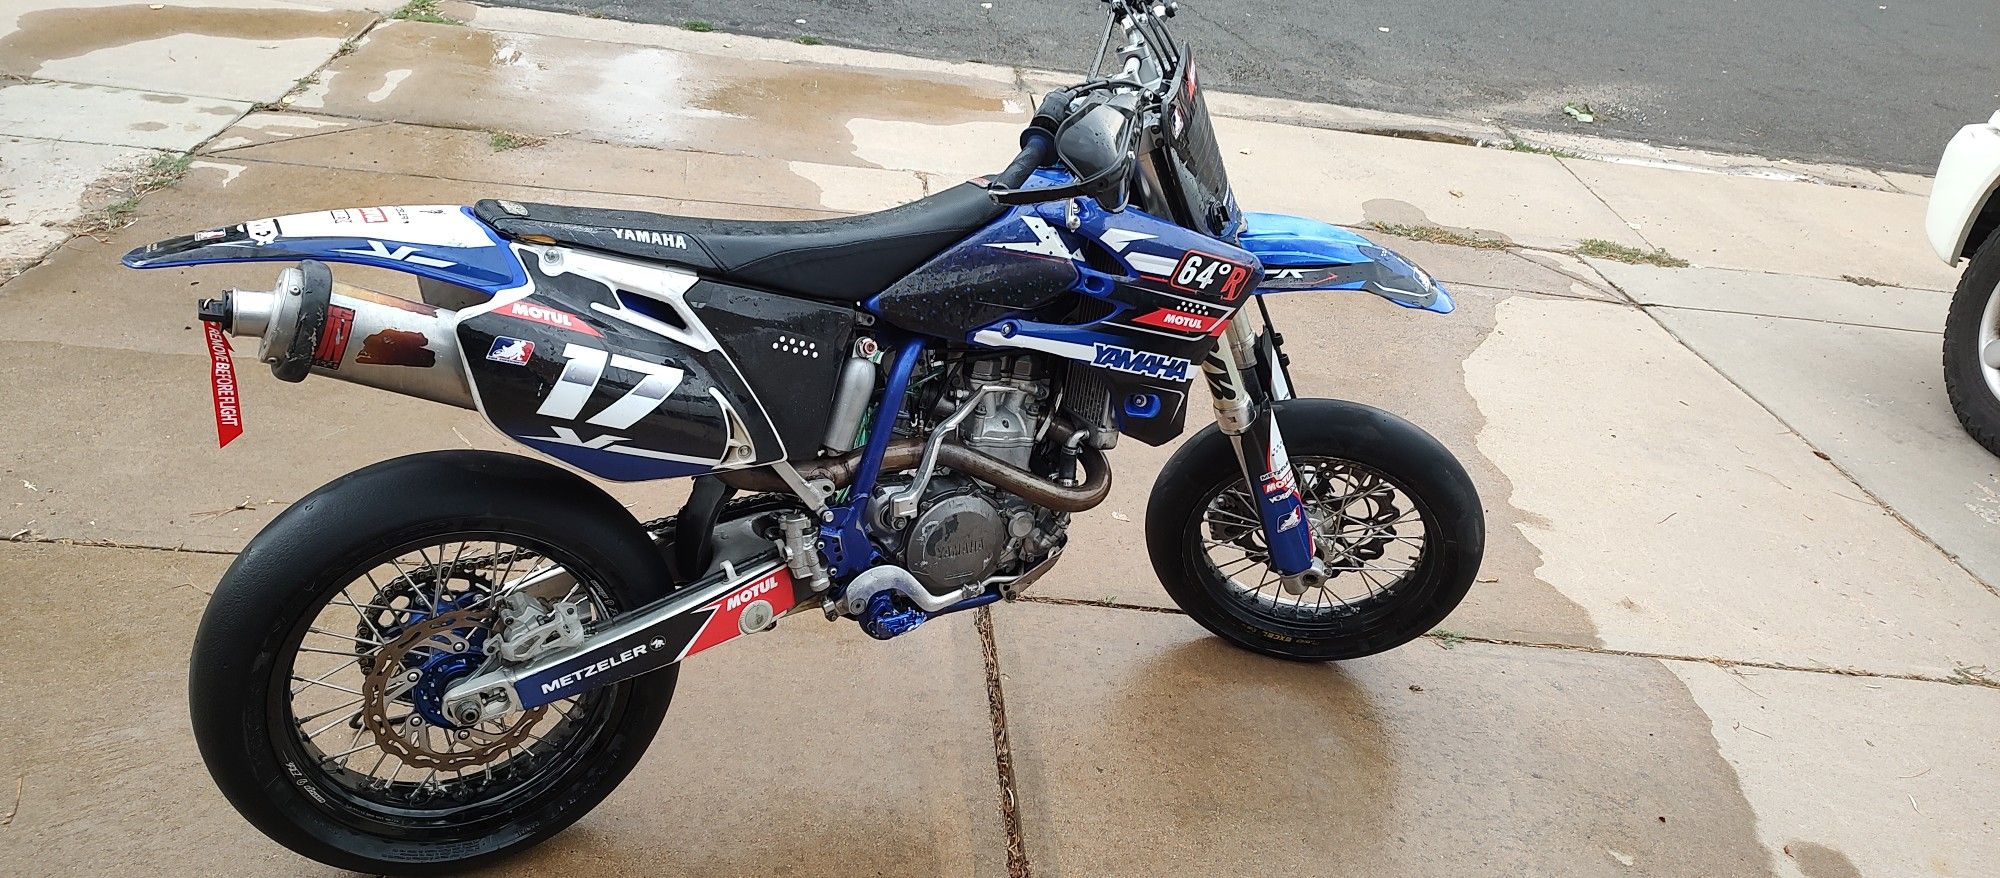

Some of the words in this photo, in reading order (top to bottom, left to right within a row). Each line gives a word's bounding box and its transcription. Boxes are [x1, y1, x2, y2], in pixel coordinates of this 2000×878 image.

[611, 227, 687, 250] YAMAHA
[511, 302, 573, 327] MOTUL
[1163, 313, 1203, 329] MOTUL
[207, 326, 230, 362] REMOVE
[215, 362, 234, 396] BEFORE
[1091, 342, 1192, 383] YAMAHA
[536, 342, 685, 430] 17
[218, 397, 238, 426] FLIGHT
[936, 538, 985, 560] YAMAHA
[726, 576, 779, 612] MOTUL
[540, 644, 648, 695] METZELER
